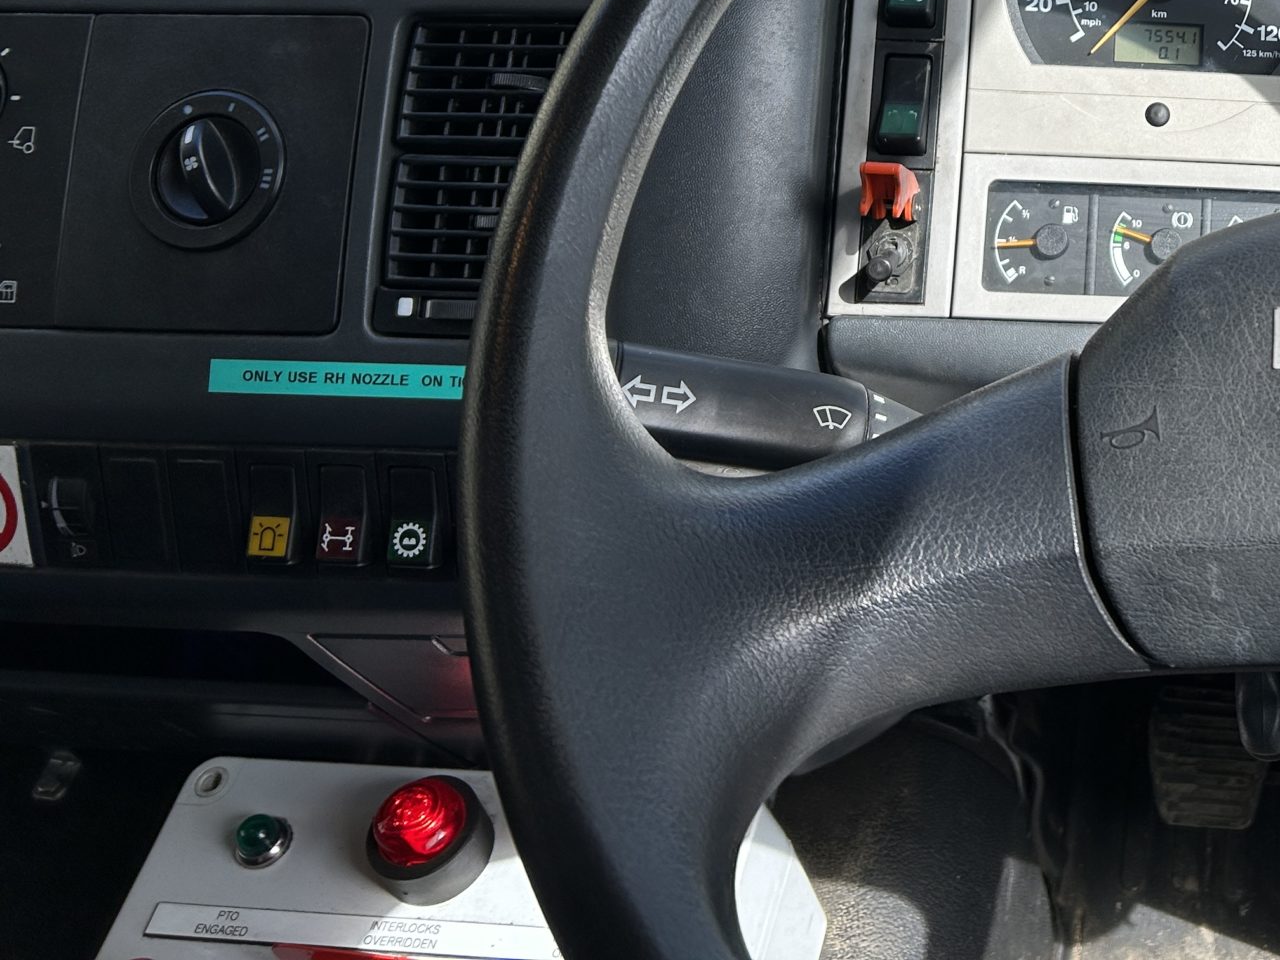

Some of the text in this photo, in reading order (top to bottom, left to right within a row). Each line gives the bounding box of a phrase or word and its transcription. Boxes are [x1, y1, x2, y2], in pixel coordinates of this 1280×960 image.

[1083, 1, 1098, 12] 10
[1151, 9, 1167, 19] km
[1080, 18, 1102, 27] mph
[1242, 49, 1280, 59] 125 km/h
[1131, 219, 1143, 228] 10
[1019, 266, 1026, 275] R
[1133, 269, 1140, 278] 0
[242, 370, 283, 382] ONLY
[287, 371, 317, 383] USE
[324, 372, 345, 384] RH
[351, 373, 409, 386] NOZZLE
[421, 375, 443, 387] ON
[216, 910, 240, 922] PTO
[194, 923, 248, 937] ENGAGED
[370, 920, 441, 935] INTERLOCKS
[364, 934, 437, 949] OVERRIDDEN
